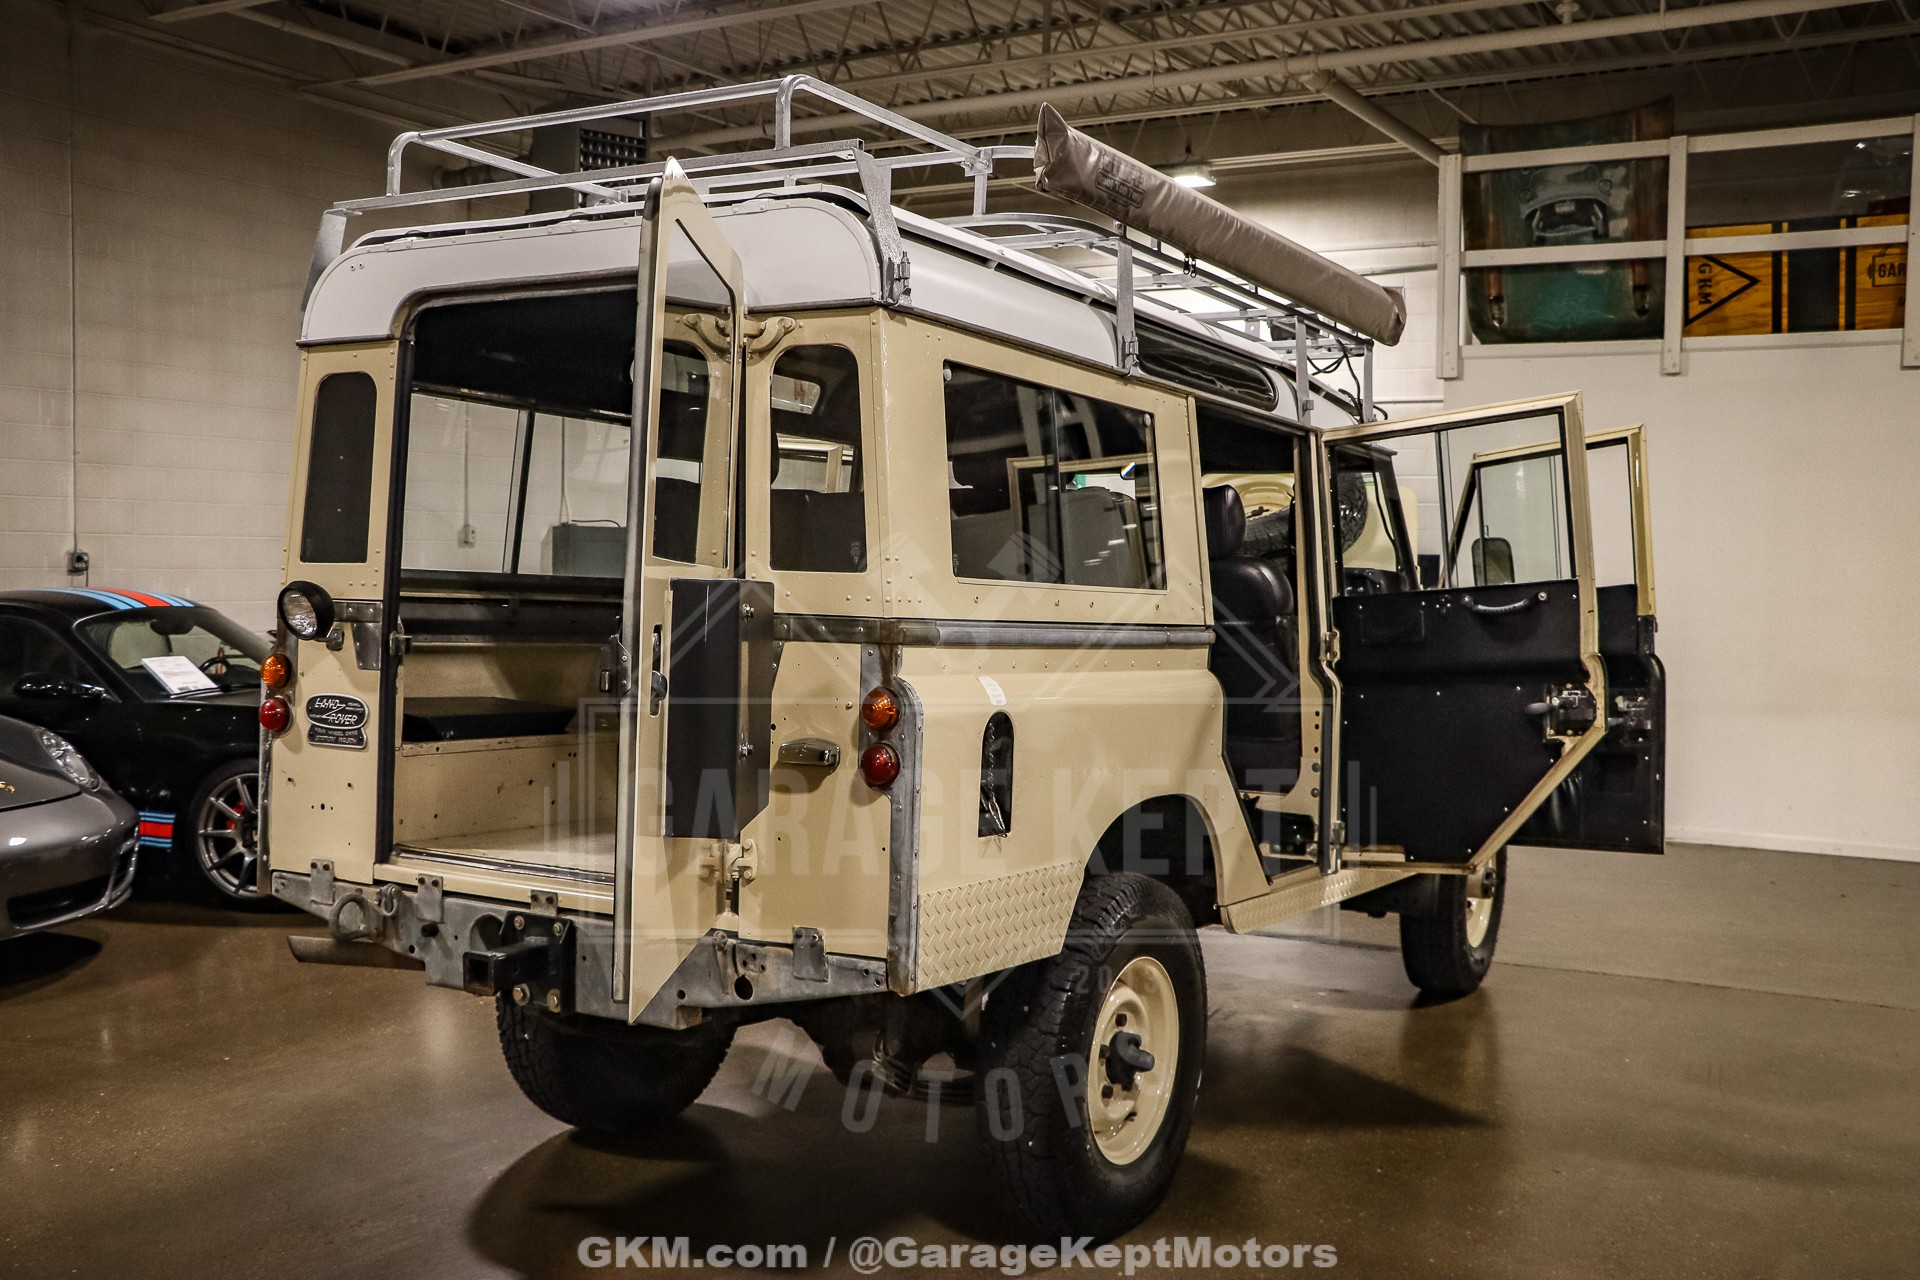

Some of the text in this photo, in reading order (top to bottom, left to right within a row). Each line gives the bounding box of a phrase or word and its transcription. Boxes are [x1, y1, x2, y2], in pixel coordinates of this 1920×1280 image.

[1697, 262, 1713, 305] GKM
[314, 698, 340, 709] LAND
[328, 713, 358, 725] ROVER
